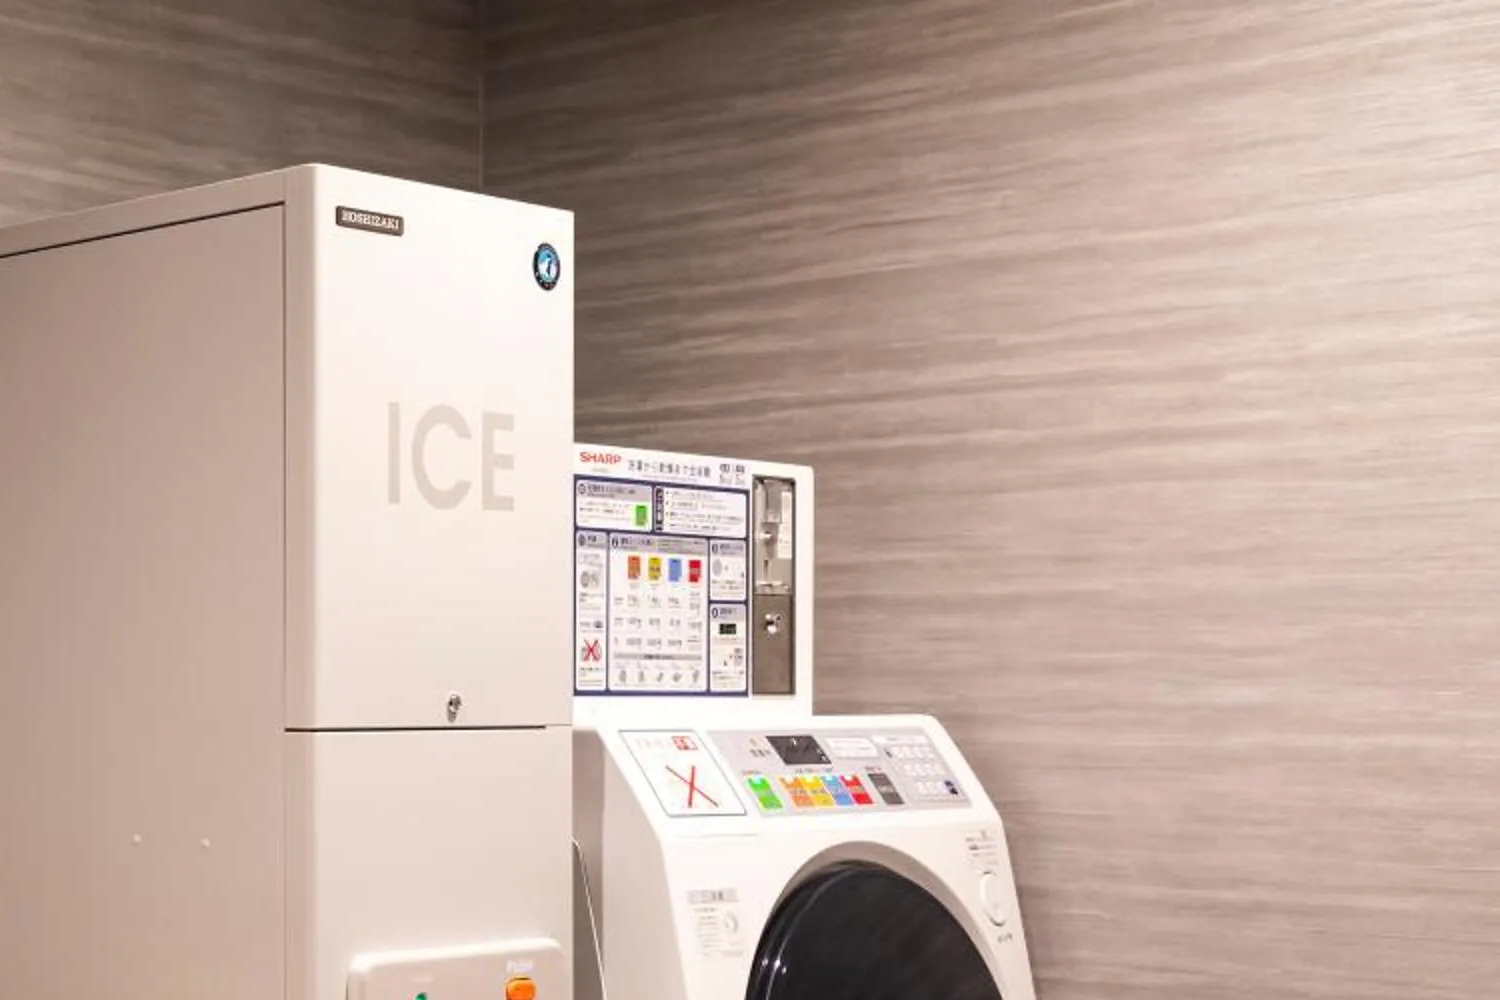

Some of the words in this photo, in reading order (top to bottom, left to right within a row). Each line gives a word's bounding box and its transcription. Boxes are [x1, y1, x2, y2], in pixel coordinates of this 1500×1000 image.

[341, 209, 400, 231] HOSHIZAKI
[387, 401, 516, 512] ICE
[579, 451, 622, 465] SHARP
